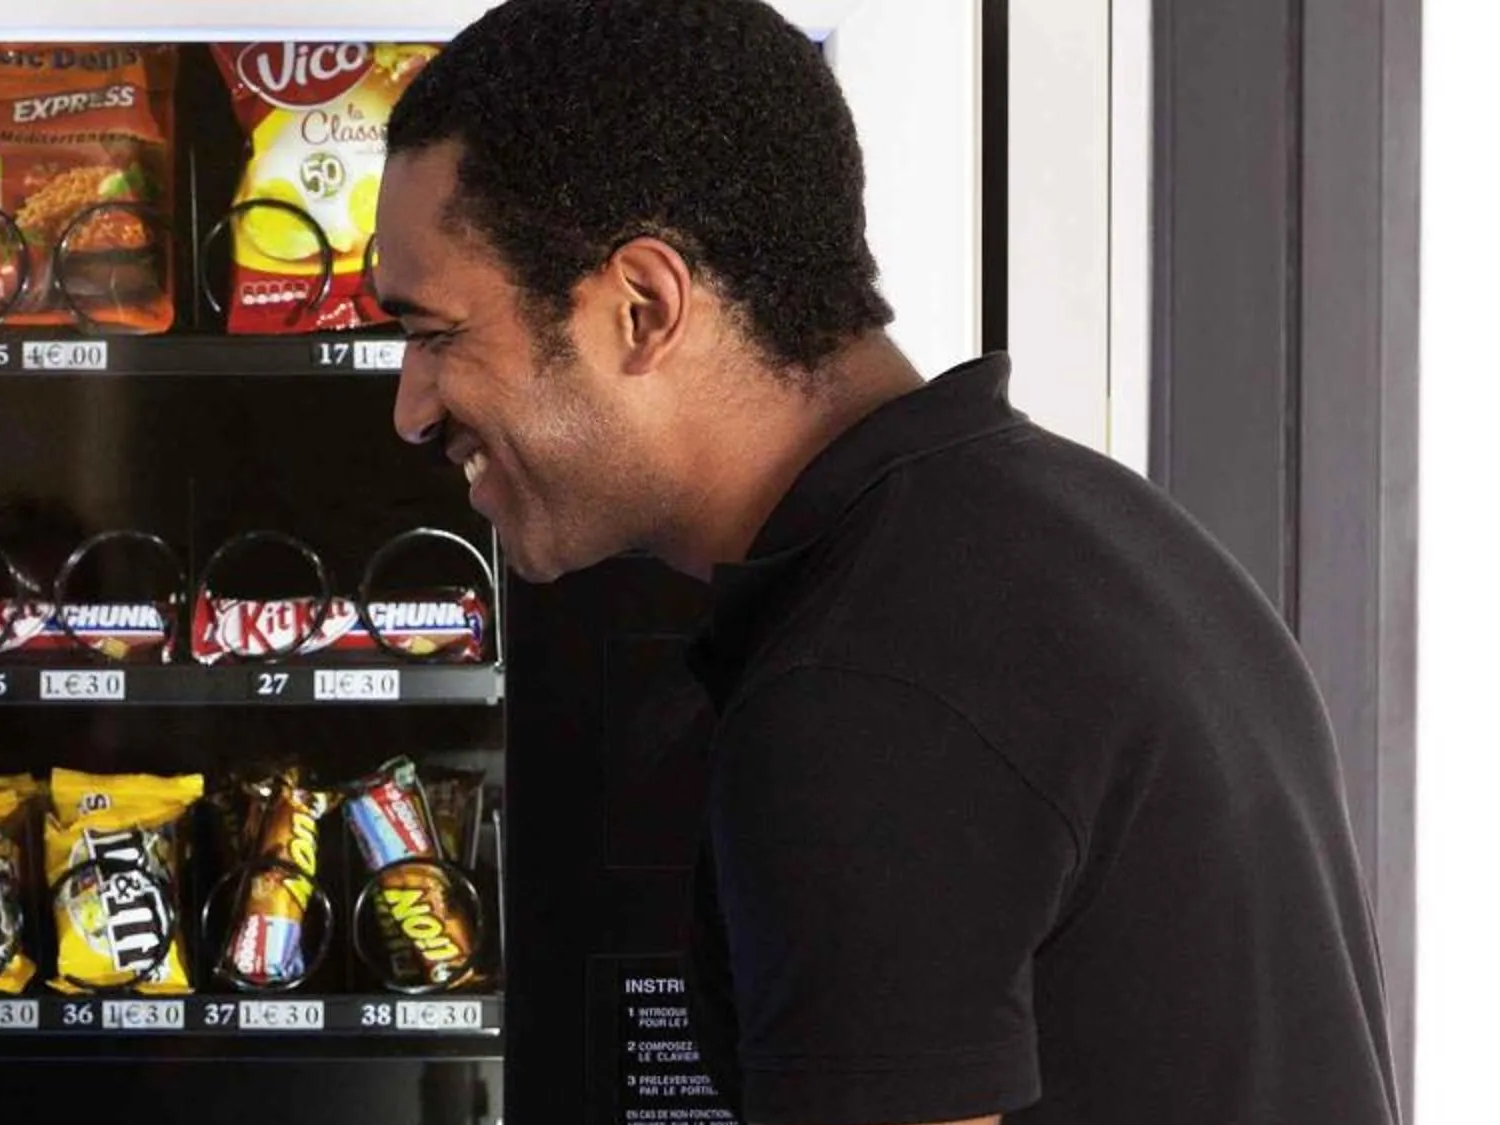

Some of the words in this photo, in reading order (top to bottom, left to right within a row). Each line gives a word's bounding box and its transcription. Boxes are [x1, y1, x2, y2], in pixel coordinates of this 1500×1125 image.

[257, 42, 366, 91] Vico
[13, 85, 135, 124] EXPRESS
[318, 343, 349, 365] 17
[257, 673, 289, 696] 27
[62, 1004, 94, 1025] 36
[204, 1003, 235, 1025] 37
[361, 1003, 391, 1026] 38
[627, 1041, 637, 1052] 2
